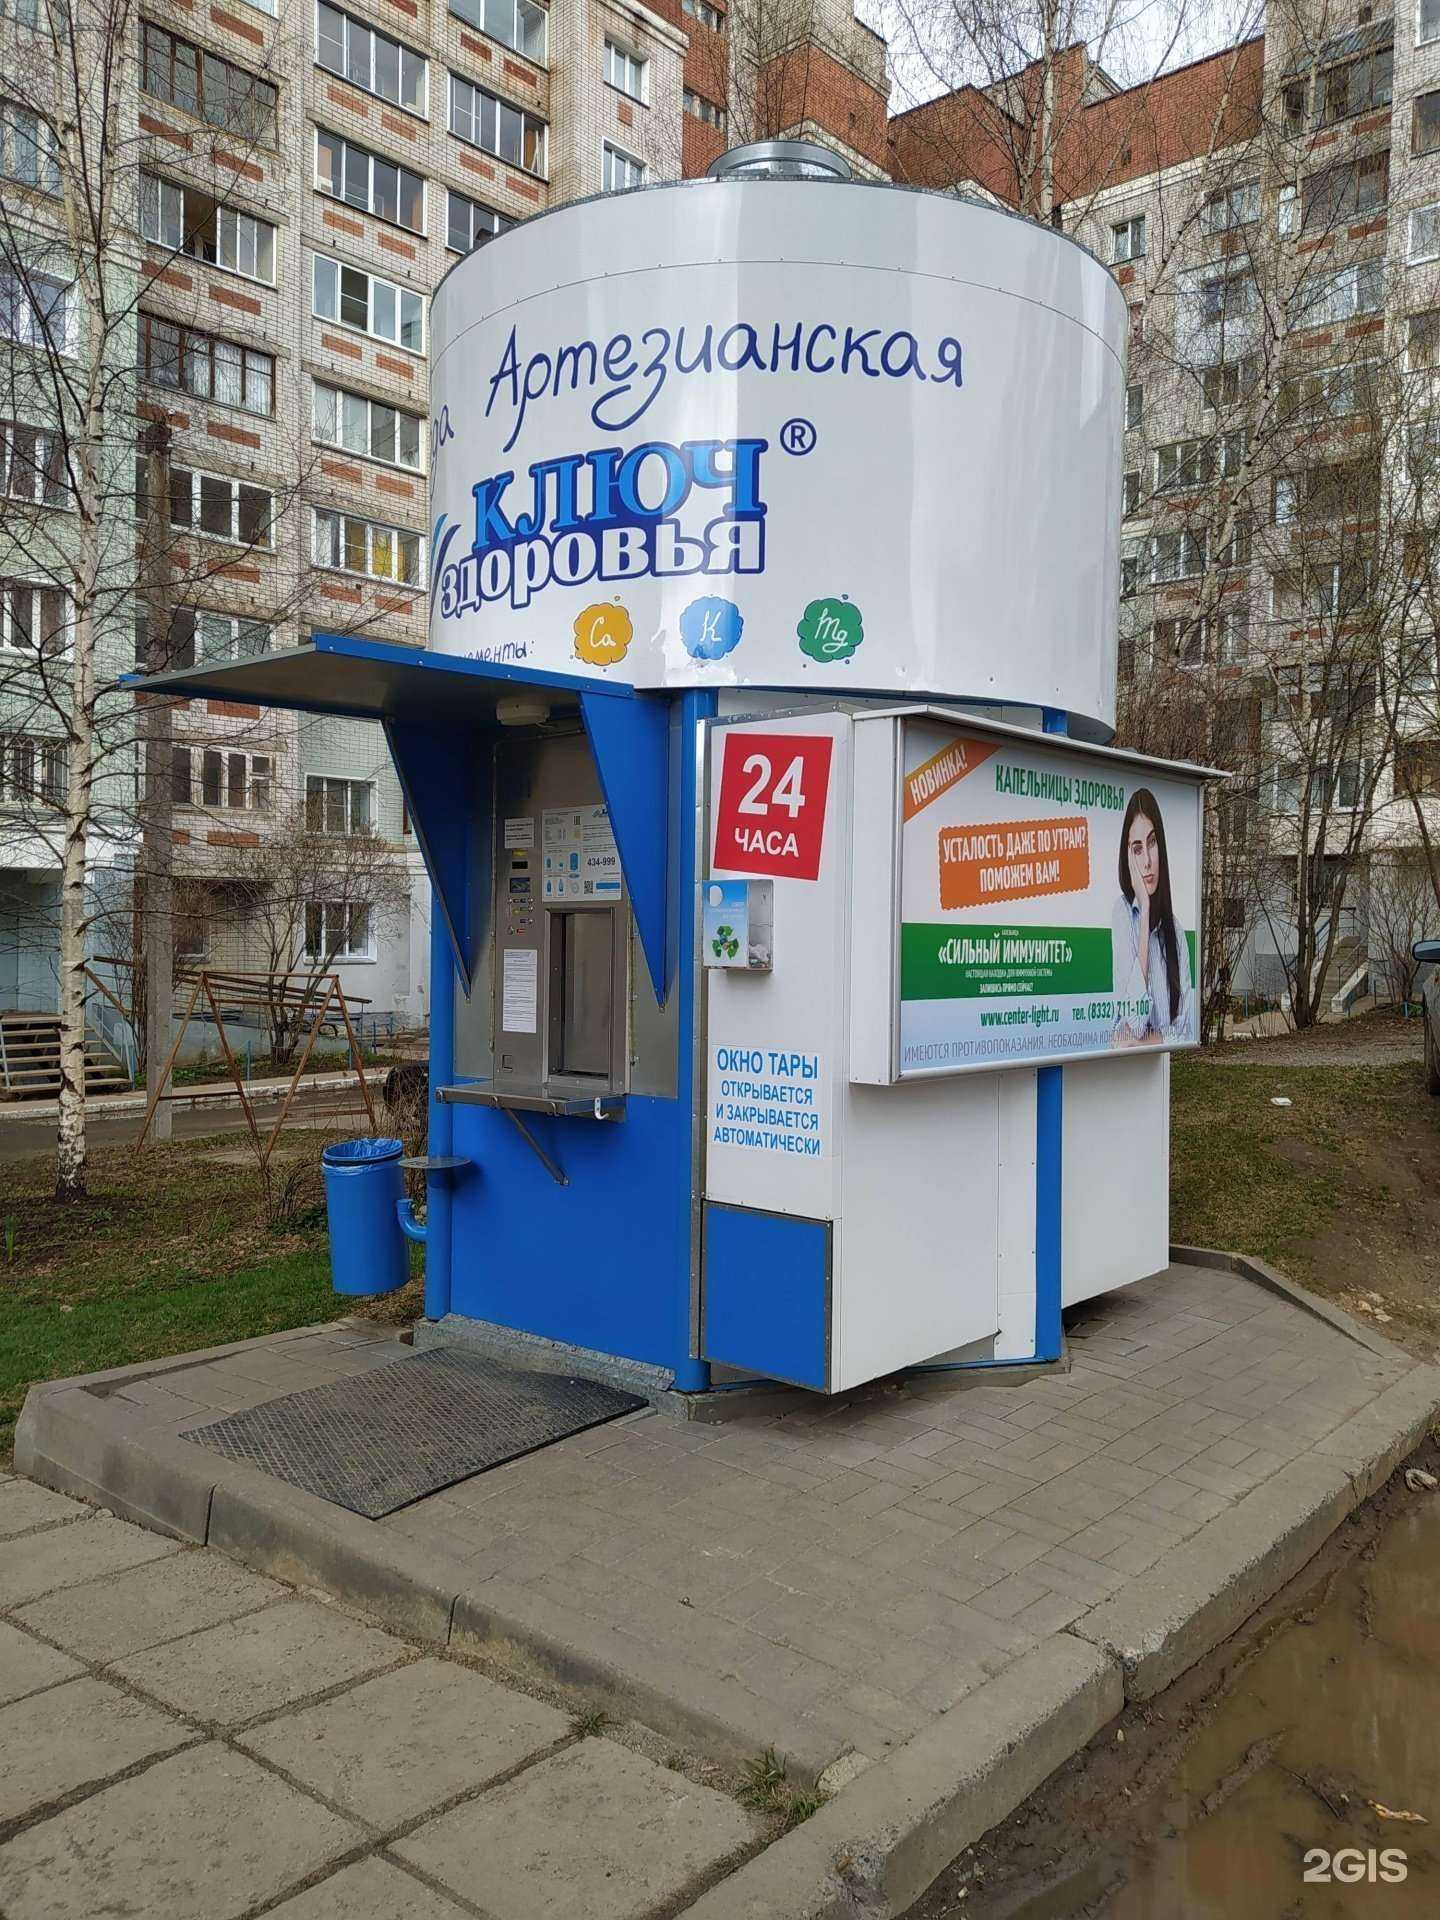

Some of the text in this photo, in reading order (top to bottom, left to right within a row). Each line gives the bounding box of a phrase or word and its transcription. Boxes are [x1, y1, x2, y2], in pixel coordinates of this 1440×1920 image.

[484, 321, 964, 453] Артезианская
[471, 437, 768, 557] КЛЮЧ
[590, 616, 616, 648] Ca
[815, 607, 849, 653] Mg
[737, 753, 806, 819] 24
[909, 744, 968, 806] НОВИНКА!
[995, 765, 1125, 811] КАПЕЛЬНИЦЫ ЗДОРОВЬЯ
[734, 828, 800, 858] ЧАСА
[943, 825, 1087, 864] УСТАЛОСТЬ ДАЖЕ ПО УТРАМ?
[586, 856, 616, 867] 434-999
[979, 859, 1060, 893] ПОМОЖЕМ ВАМ!
[937, 932, 1073, 965] «СИЛЬНЫЙ ИММУНИТЕТ»
[980, 1005, 1060, 1027] www.center-light.ru
[1072, 1007, 1086, 1020] тел.
[1087, 1001, 1115, 1020] (8332)
[904, 1042, 950, 1063] ИМЕЮТСЯ
[1048, 1030, 1098, 1049] НЕОБХОДИМА
[717, 1048, 818, 1080] ОКНО ТАРЫ
[721, 1080, 813, 1105] ОТКРЫВАЕТСЯ
[716, 1103, 819, 1131] И ЗАКРЫВАЕТСЯ
[714, 1126, 821, 1156] АВТОМАТИЧЕСКИ
